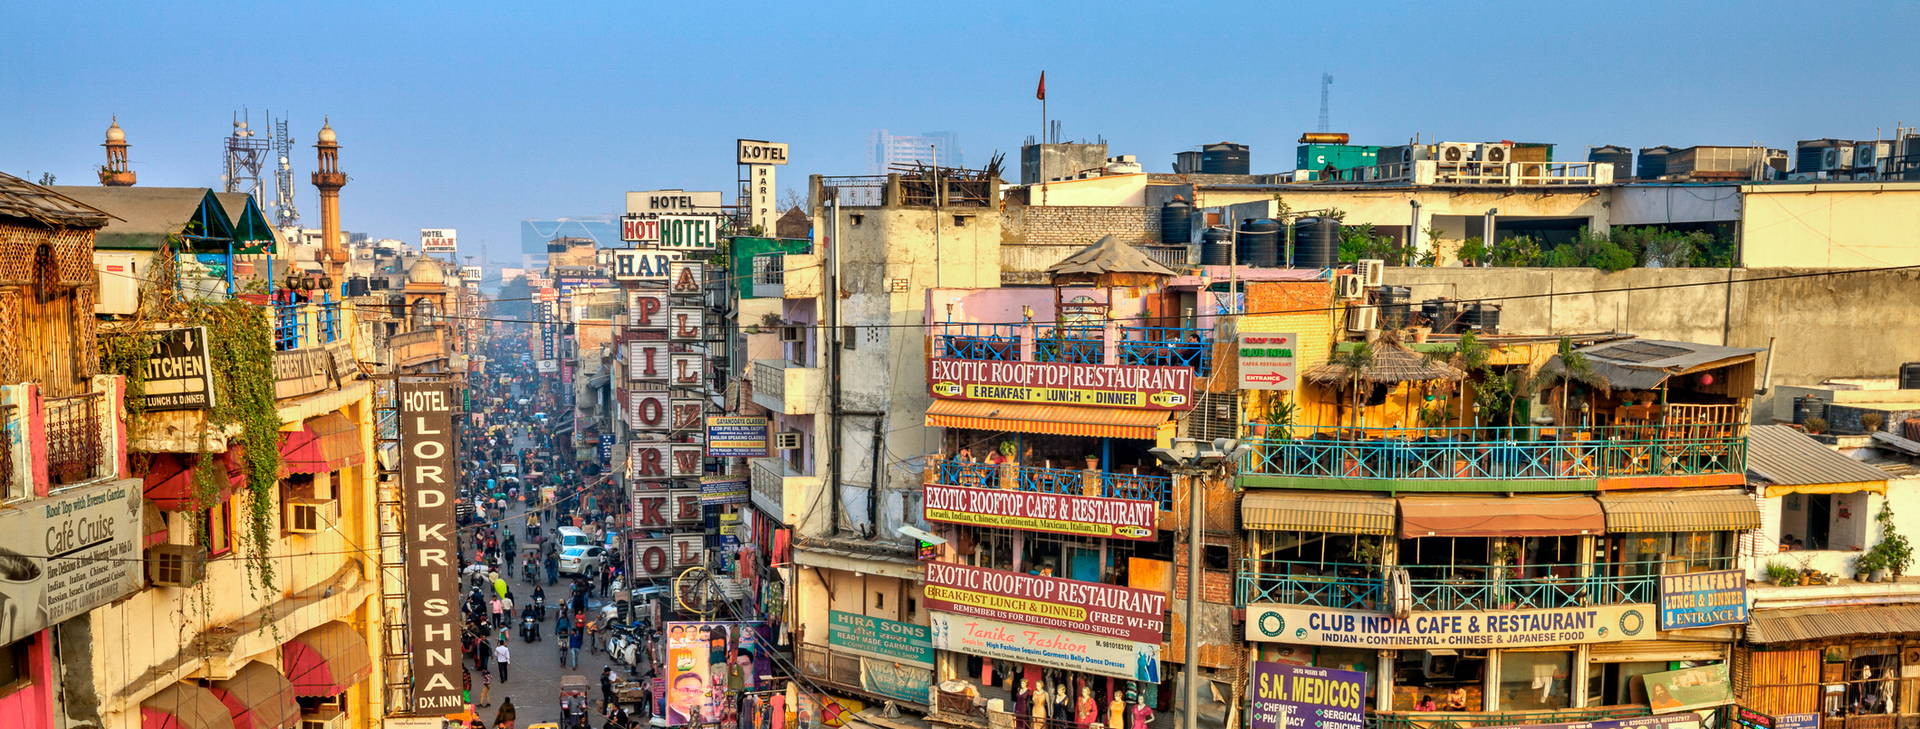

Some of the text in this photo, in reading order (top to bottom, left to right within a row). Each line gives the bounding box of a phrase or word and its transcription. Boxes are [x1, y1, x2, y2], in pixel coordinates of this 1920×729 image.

[742, 146, 786, 160] HOTEL
[651, 196, 695, 209] HOTEL
[624, 221, 659, 240] HOT
[660, 219, 715, 247] HOTEL
[425, 238, 454, 246] AMAN
[616, 255, 681, 276] HAR
[1240, 348, 1293, 358] CLUB INDIA
[931, 360, 1189, 390] EXOTIC ROOFTOP RESTAURANT
[147, 394, 205, 407] LUNCH & DINNER
[403, 391, 449, 412] HOTEL
[973, 386, 1137, 405] BREAKFAST LUNCH DINNER
[46, 487, 126, 519] Roof Top with Everest Garden
[926, 486, 1153, 527] EXOTIC ROOFTOP CAFE & RESTAURANT
[951, 511, 973, 522] Indian,
[974, 513, 998, 524] Chinese,
[1000, 516, 1038, 528] Continental,
[46, 514, 114, 555] Café Cruise
[47, 566, 58, 580] Have
[58, 560, 76, 575] Delicious
[109, 544, 118, 557] Food
[413, 416, 456, 692] LORD KRISHNA
[927, 563, 1166, 616] EXOTIC ROOFTOP RESTAURANT
[1665, 572, 1743, 593] BREAKFAST
[927, 586, 1164, 633] BREAKFAST LUNCH & DINNER (FREE WI-FI)
[1665, 591, 1744, 609] LUNCH & DINNER
[838, 614, 875, 629] HIRA
[880, 621, 925, 638] SONS
[953, 604, 996, 617] REMEMBER
[1008, 612, 1024, 621] FOR
[1025, 614, 1067, 627] DELICIOUS
[1068, 620, 1090, 631] FOOD
[1091, 624, 1130, 637] SERVICES
[1309, 613, 1356, 632] CLUB
[1361, 615, 1410, 634] INDIA
[1416, 616, 1462, 634] CAFE
[1468, 616, 1480, 633] &
[1486, 611, 1598, 633] RESTAURANT
[1675, 610, 1735, 625] ENTRANCE
[837, 631, 860, 641] READY
[862, 636, 882, 646] MADE
[883, 640, 925, 655] GARMENTS
[963, 621, 1088, 653] Tanika Fashion
[1322, 631, 1585, 645] INDIAN CONTINENTAL CHINESE & JAPANESE FOOD
[986, 641, 999, 650] High
[1000, 643, 1021, 652] Fashion
[1043, 650, 1070, 660] Garments
[1070, 654, 1085, 664] Belly
[1085, 656, 1103, 665] Dance
[1104, 659, 1126, 668] Dresses
[1259, 672, 1360, 709] S.N. MEDICOS
[1263, 702, 1298, 715] CHEMIST
[1323, 709, 1362, 722] SERGICAL
[1786, 715, 1813, 723] TUITION
[1262, 713, 1305, 726] PHAMACY
